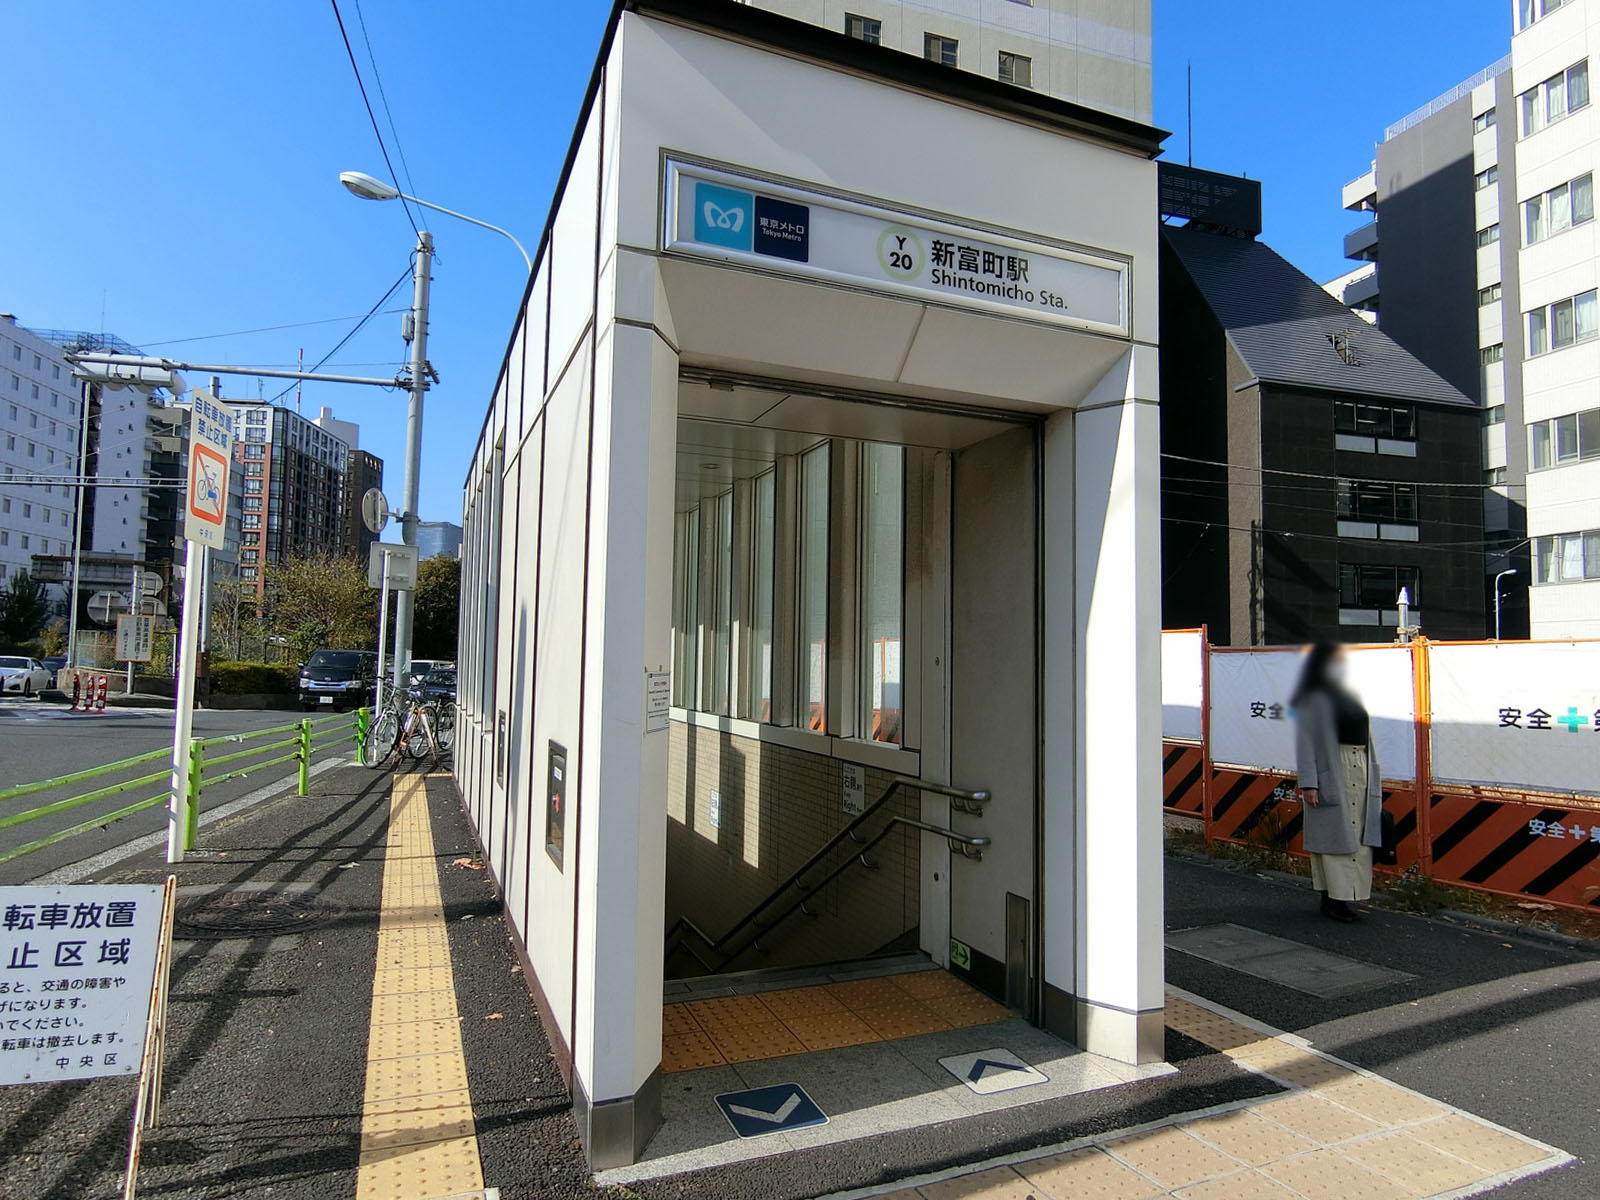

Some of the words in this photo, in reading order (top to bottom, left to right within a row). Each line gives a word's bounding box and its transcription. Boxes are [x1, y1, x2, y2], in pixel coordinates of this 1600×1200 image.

[759, 217, 804, 234] 東京メトロ
[762, 227, 782, 238] Tokyo
[782, 232, 802, 242] Metro
[895, 235, 907, 250] Y
[889, 251, 913, 270] 20
[931, 239, 1029, 284] 新富町駅
[931, 268, 1034, 303] Shintomicho
[1039, 290, 1069, 310] Sta.
[195, 397, 232, 433] 自転車放置
[198, 418, 228, 449] 禁止区域
[1250, 701, 1285, 720] 安全
[1498, 706, 1552, 730] 安全
[1273, 786, 1297, 802] 安全
[1529, 819, 1566, 839] 安全
[2, 902, 136, 931] 転車放置
[6, 938, 131, 969] 止区域
[0, 1017, 84, 1031] でください。
[1, 1032, 125, 1051] 転車は撤去します。
[56, 1053, 118, 1069] 中央区
